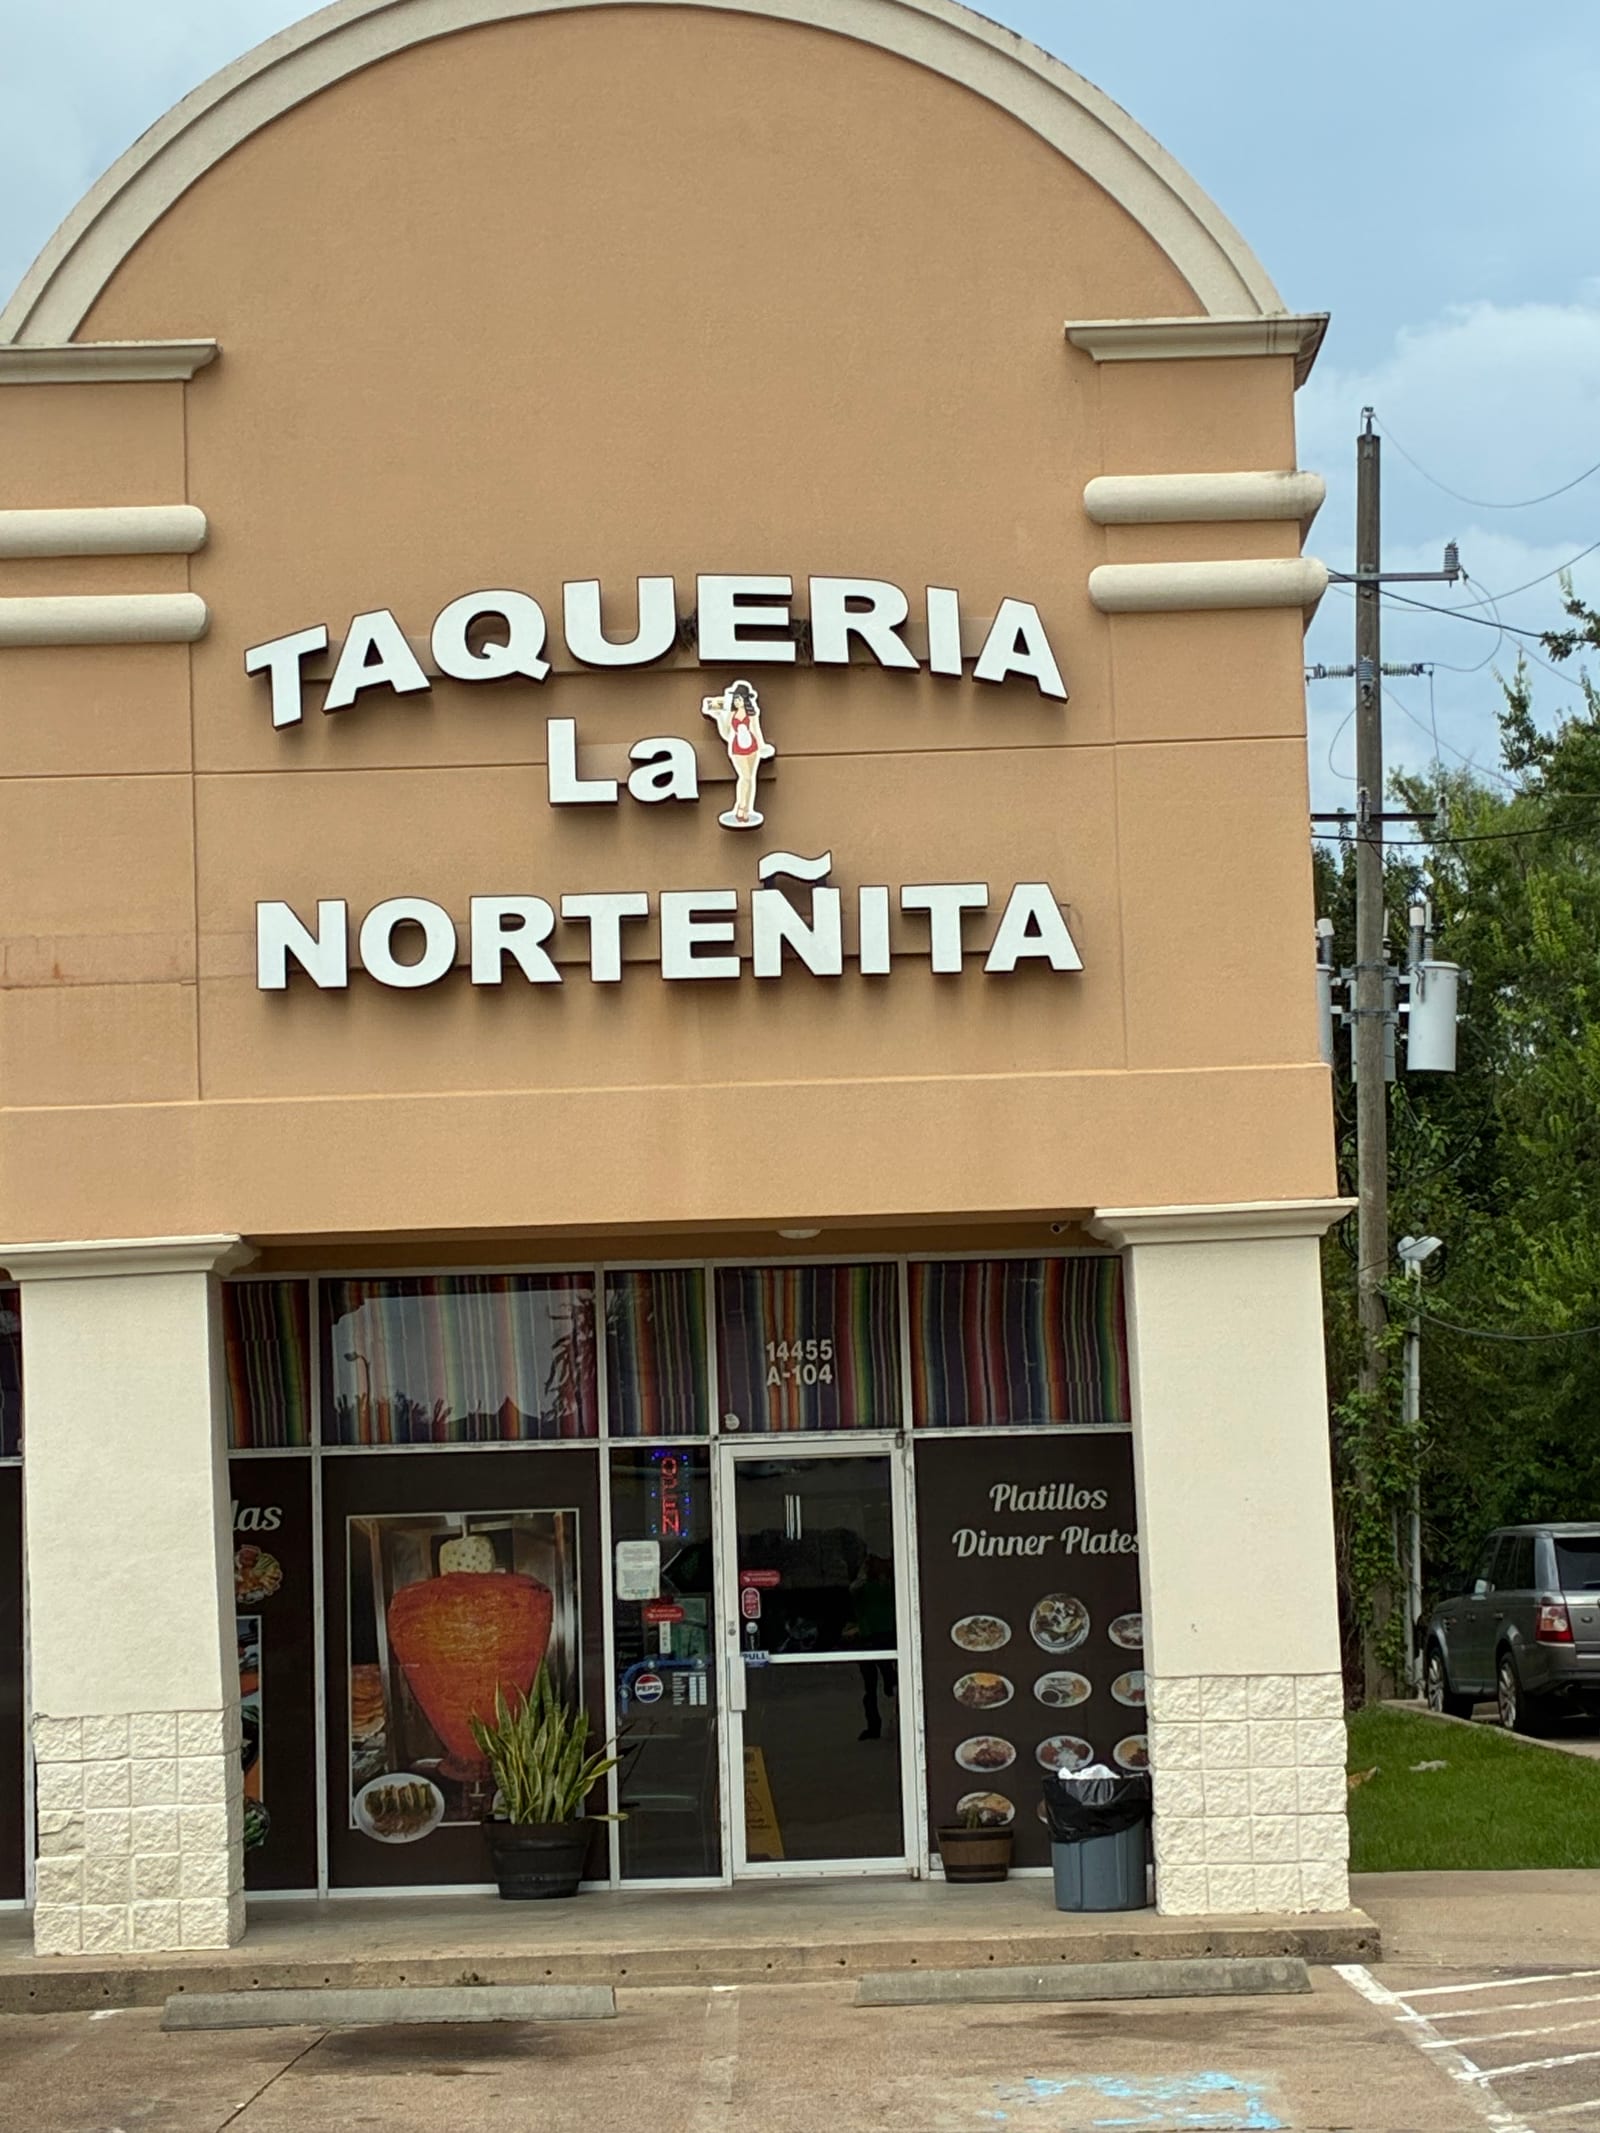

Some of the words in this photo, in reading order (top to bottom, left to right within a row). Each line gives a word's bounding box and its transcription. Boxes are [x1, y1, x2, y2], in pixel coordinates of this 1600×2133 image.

[243, 574, 1069, 730] TAQUERIA
[547, 717, 699, 806] La
[255, 850, 1083, 991] NORTEÑITA
[766, 1339, 833, 1361] 14455
[766, 1364, 833, 1387] A-104
[661, 1457, 681, 1536] OPEN
[988, 1483, 1108, 1512] Platillos
[952, 1528, 1055, 1558] Dinner
